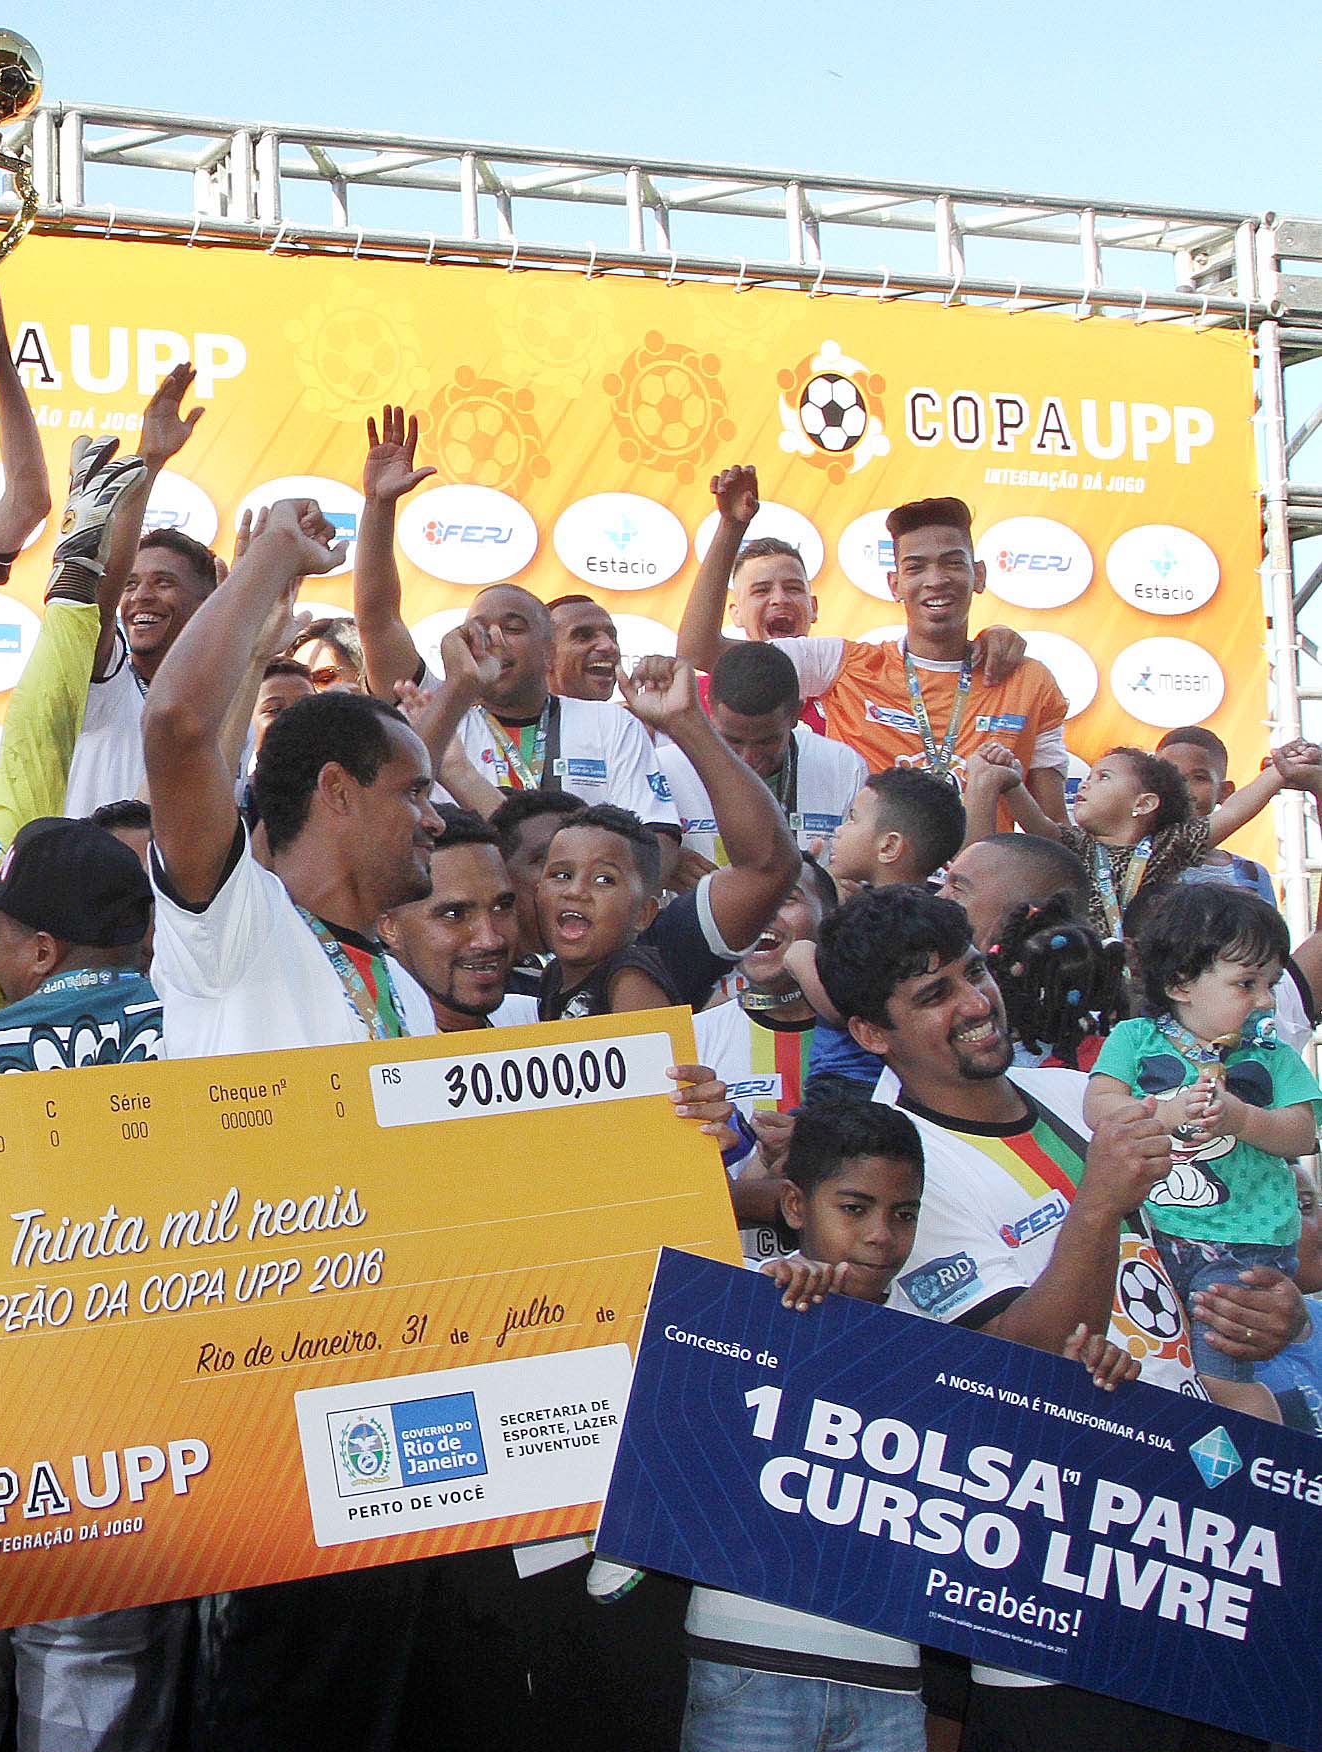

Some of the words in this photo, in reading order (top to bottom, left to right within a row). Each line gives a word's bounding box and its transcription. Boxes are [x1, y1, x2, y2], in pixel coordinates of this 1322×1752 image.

[67, 408, 94, 429] DÁ
[99, 413, 145, 431] JOG
[983, 467, 1077, 491] INTEGRAÇÃO
[1082, 471, 1102, 491] DÁ
[1105, 475, 1145, 493] JOGO
[442, 524, 514, 544] FERJ
[1013, 553, 1073, 572] FERJ
[1158, 673, 1211, 692] masan
[444, 1047, 627, 1108] 30.000,00
[46, 1100, 57, 1118] C
[110, 1092, 152, 1113] Série
[209, 1080, 268, 1103] Cheque
[330, 1073, 341, 1091] C
[121, 1121, 149, 1141] 000
[221, 1108, 274, 1130] 000000
[10, 1203, 150, 1268] Trinta
[159, 1186, 240, 1251] mil
[247, 1184, 367, 1240] reais
[1011, 1198, 1067, 1241] FERJ
[83, 1283, 128, 1322] DA
[139, 1267, 226, 1314] COPA
[235, 1256, 302, 1302] UPP
[308, 1246, 385, 1294] 2016
[936, 1258, 972, 1286] RIO
[196, 1341, 235, 1374] Rio
[244, 1335, 275, 1367] de
[401, 1313, 428, 1345] 31
[450, 1327, 470, 1345] de
[496, 1295, 566, 1348] julho
[595, 1306, 616, 1323] de
[663, 1324, 750, 1362] Concessão
[754, 1346, 779, 1370] de
[500, 1403, 588, 1427] SECRETARIA
[592, 1399, 610, 1413] DE
[935, 1372, 947, 1385] A
[949, 1375, 995, 1399] NOSSA
[998, 1388, 1029, 1408] VIDA
[1032, 1397, 1040, 1412] É
[1043, 1401, 1134, 1440] TRANSFORMAR
[1136, 1430, 1146, 1443] A
[1148, 1434, 1176, 1452] SUA.
[401, 1423, 453, 1440] GOVERNO
[455, 1420, 472, 1432] DO
[503, 1421, 571, 1443] ESPORTE,
[574, 1413, 618, 1432] LAZER
[402, 1439, 435, 1457] Rio
[437, 1435, 461, 1452] de
[506, 1445, 515, 1458] E
[518, 1433, 601, 1458] JUVENTUDE
[406, 1450, 478, 1476] Janeiro
[744, 1384, 783, 1440] 1
[1088, 1479, 1283, 1587] PARA
[348, 1500, 403, 1520] PERTO
[410, 1495, 433, 1511] DE
[438, 1484, 485, 1505] VOCÊ
[79, 1519, 98, 1541] DÁ
[104, 1516, 144, 1537] JOGO
[758, 1456, 1021, 1571] CURSO
[1041, 1533, 1254, 1642] LIVRE
[925, 1569, 1084, 1637] Parabéns!
